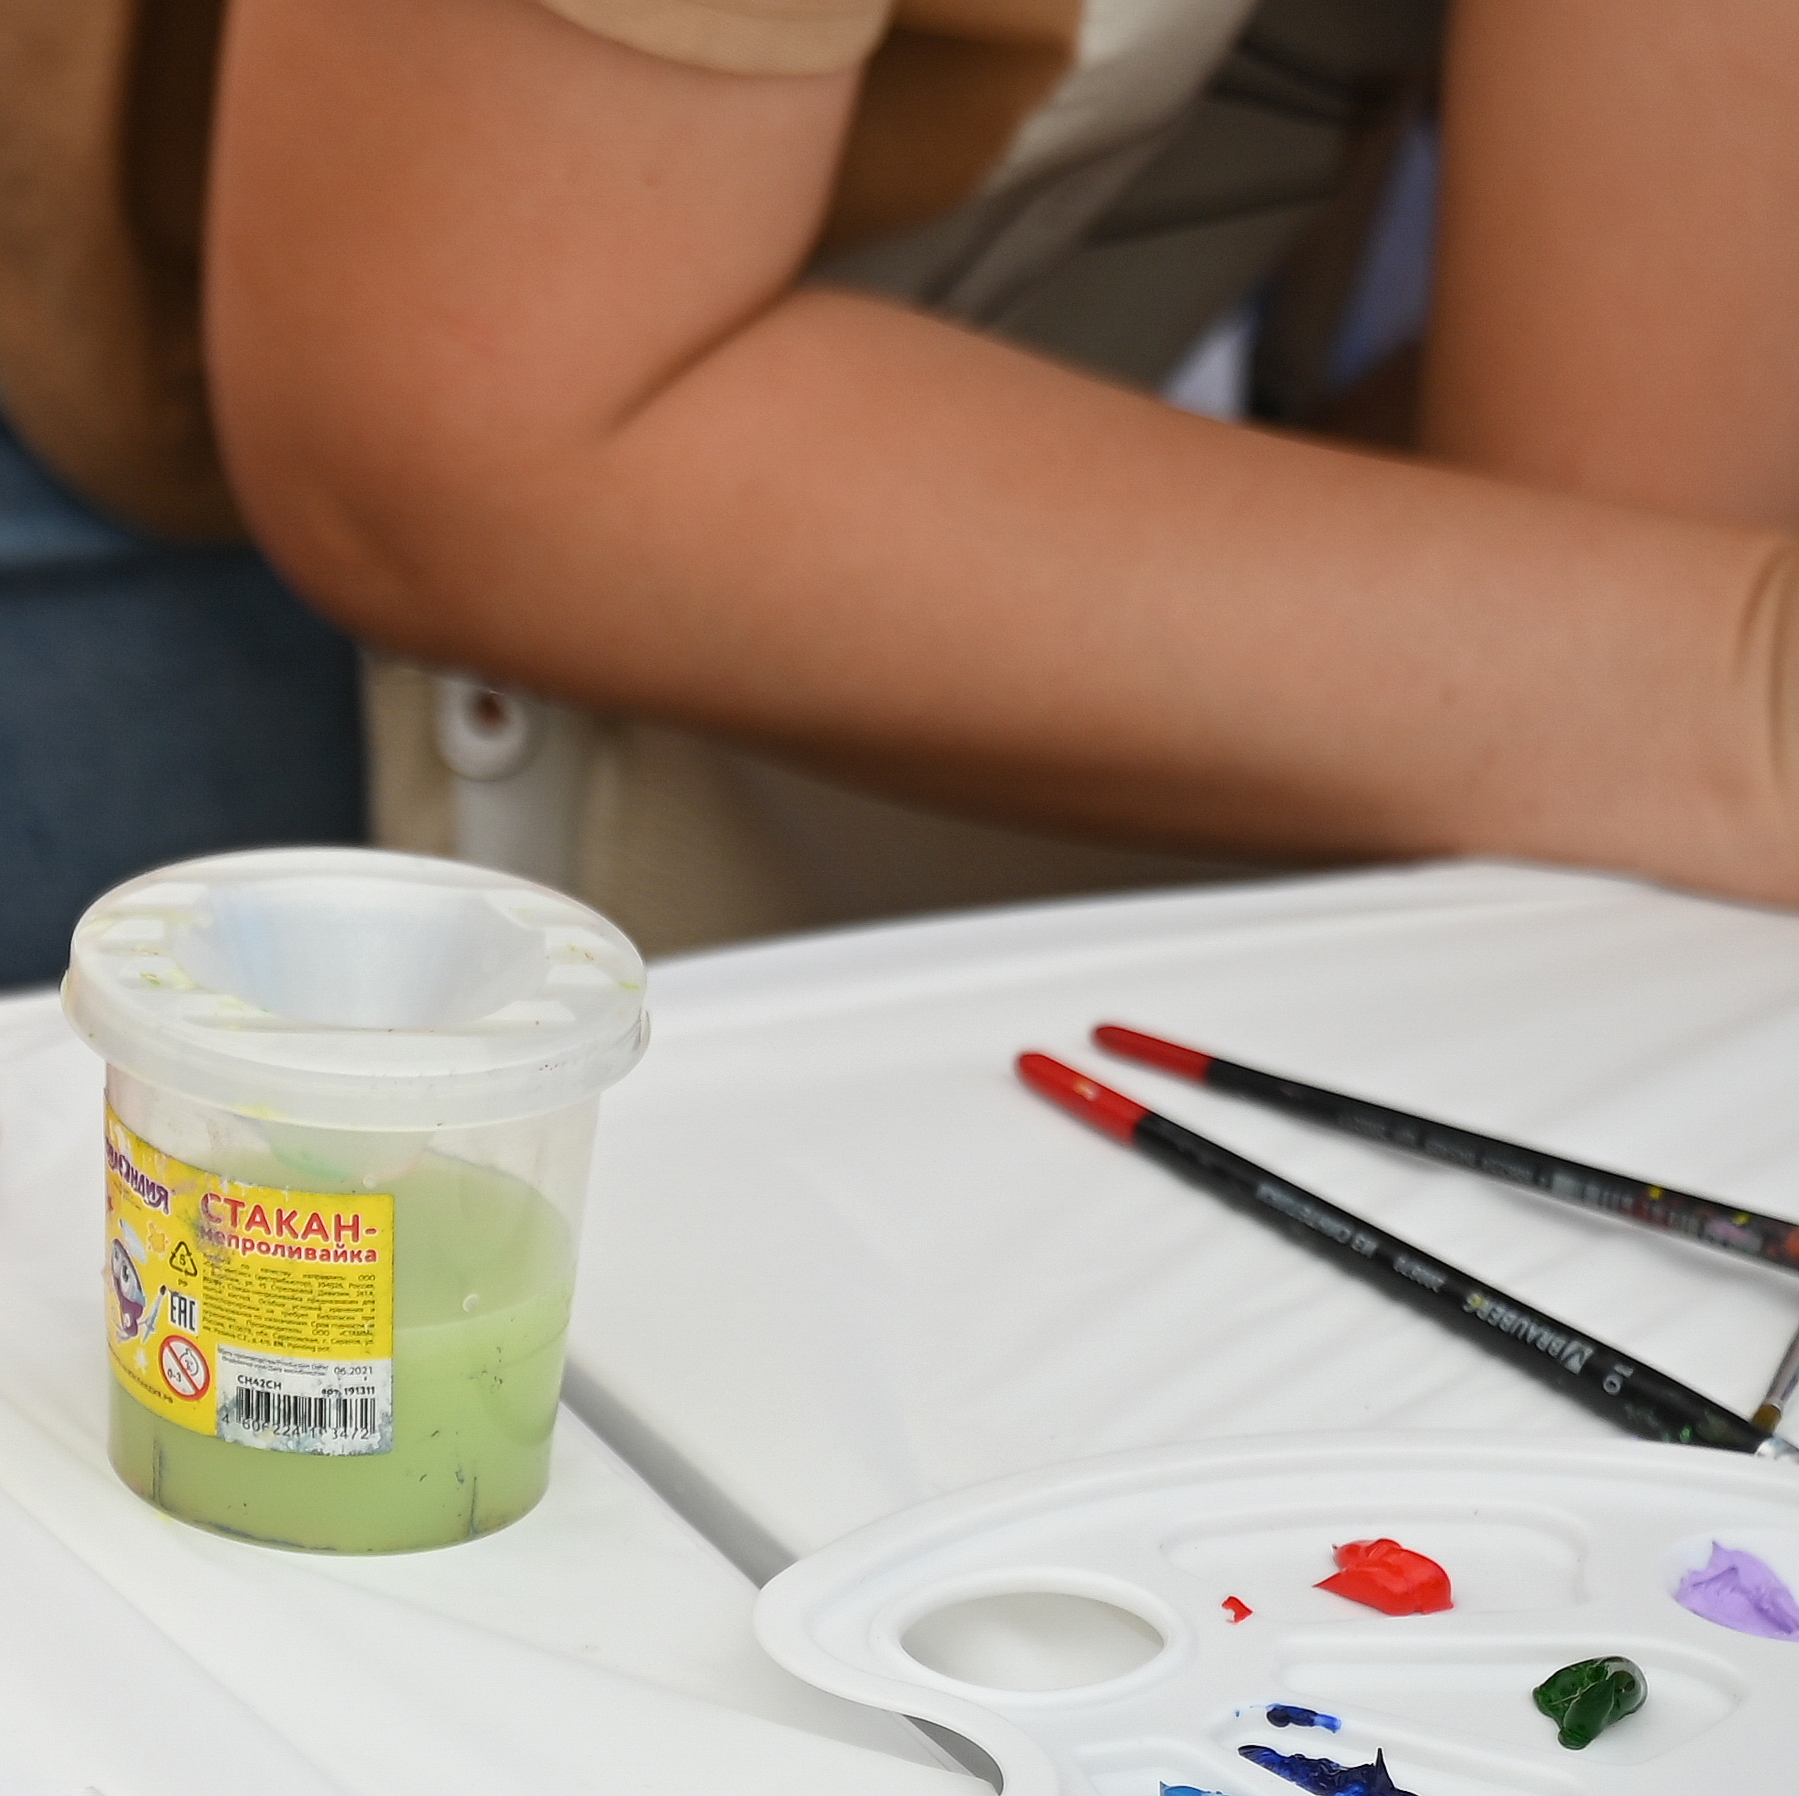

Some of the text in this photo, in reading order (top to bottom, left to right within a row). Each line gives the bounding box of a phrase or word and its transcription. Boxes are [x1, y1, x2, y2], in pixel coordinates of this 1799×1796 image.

[200, 1192, 379, 1243] СТАКАН-
[200, 1227, 379, 1263] непроливайка
[1462, 1291, 1567, 1360] BRAUBERG
[167, 1368, 182, 1383] 0-3
[344, 1385, 376, 1396] 191311
[1603, 1363, 1634, 1396] 10
